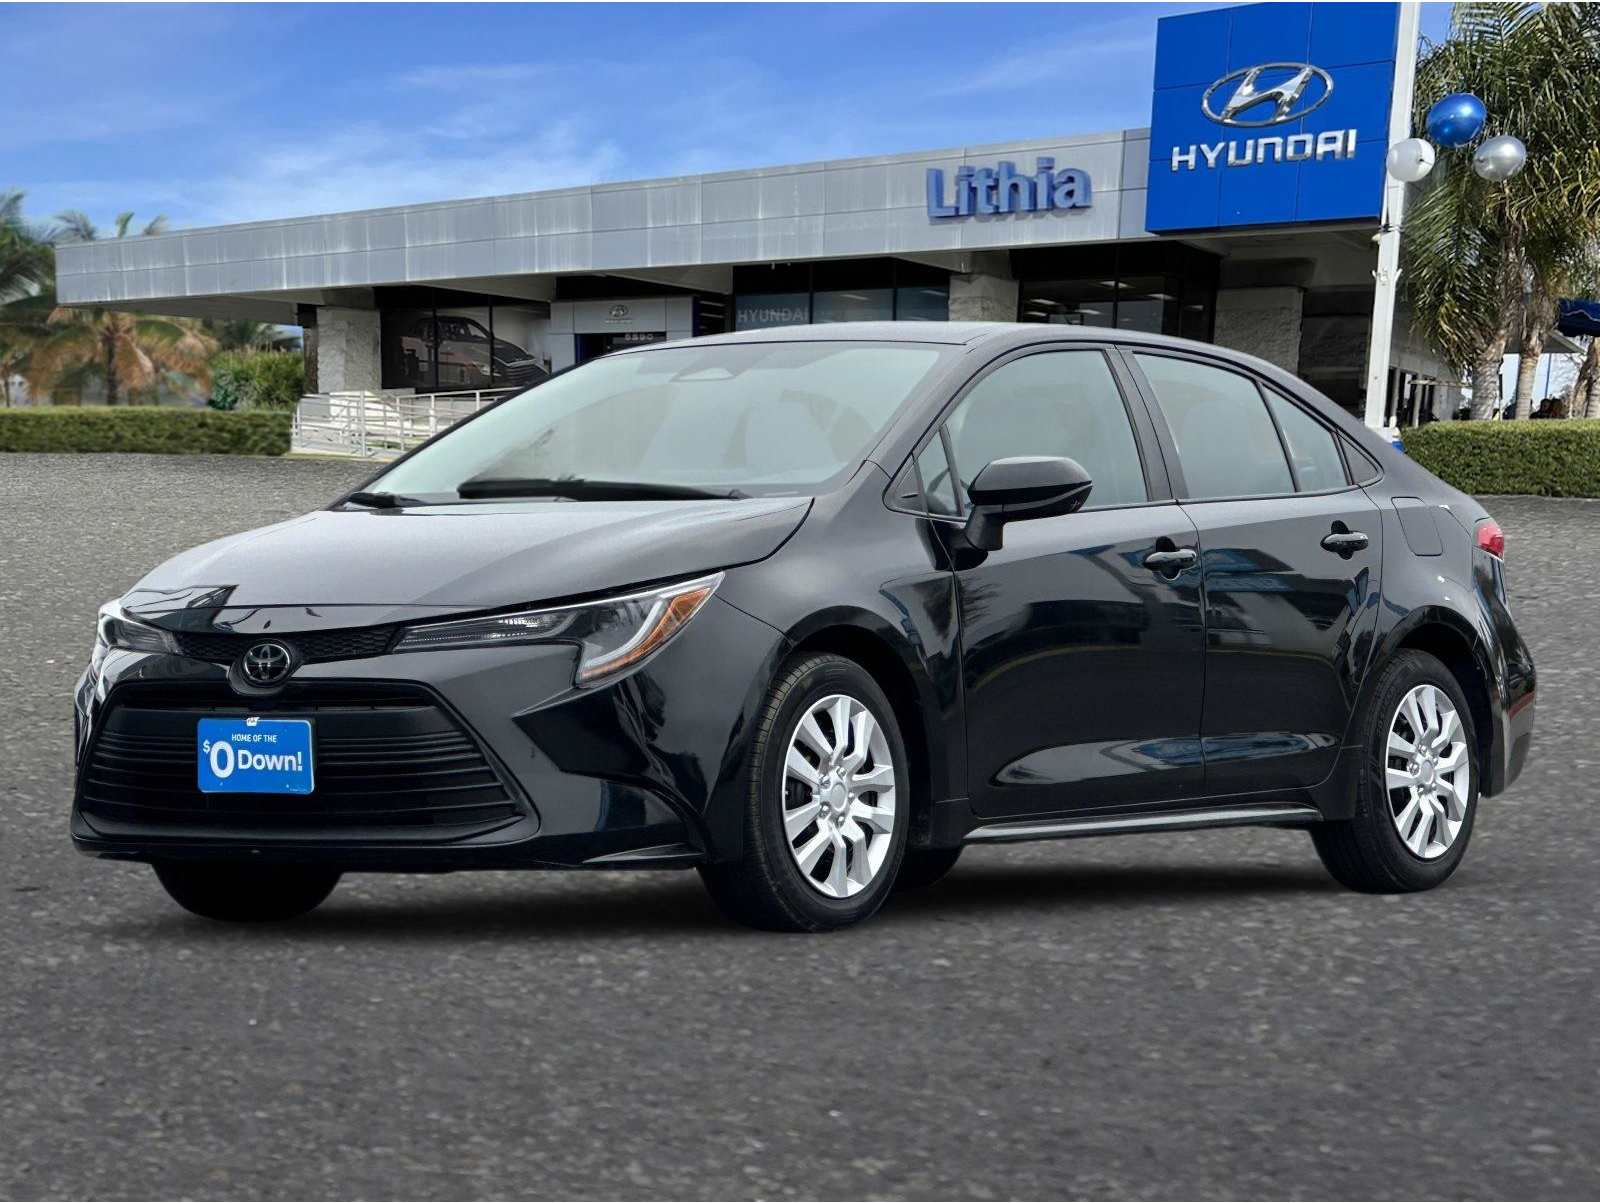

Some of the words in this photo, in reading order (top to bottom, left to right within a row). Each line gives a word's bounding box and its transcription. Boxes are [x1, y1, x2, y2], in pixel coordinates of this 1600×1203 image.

[1171, 129, 1357, 172] HYUNDAI
[926, 156, 1093, 217] Lithia
[737, 307, 809, 322] HYUNDAI
[231, 733, 252, 742] HOME
[252, 734, 262, 742] OF
[263, 734, 278, 743] THE
[237, 749, 303, 771] Down!
